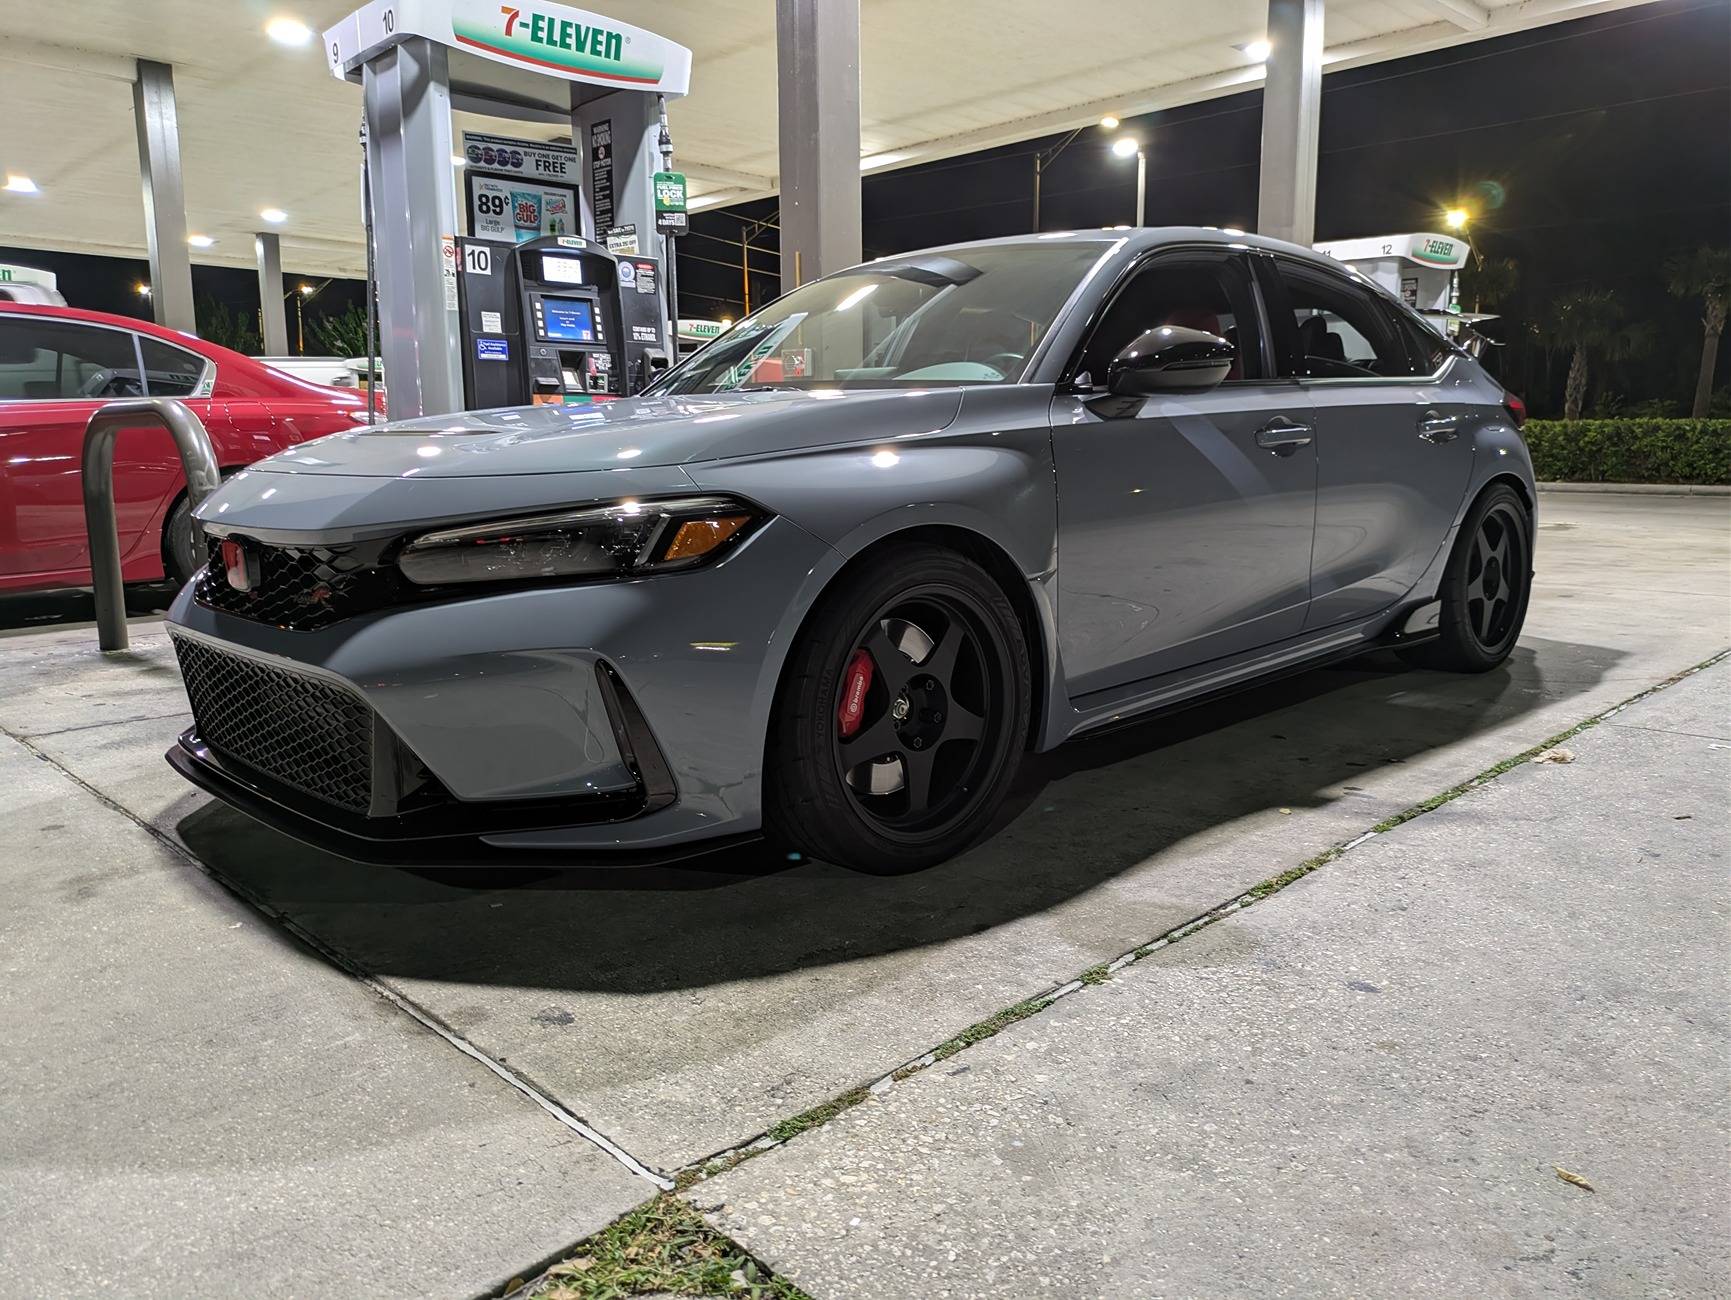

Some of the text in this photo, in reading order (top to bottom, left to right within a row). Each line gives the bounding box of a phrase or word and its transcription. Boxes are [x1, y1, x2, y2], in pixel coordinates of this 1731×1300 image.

[383, 9, 394, 34] 10
[332, 42, 339, 64] 9
[537, 152, 551, 160] ONE
[535, 159, 567, 174] FREE
[657, 189, 684, 199] LOCK
[485, 218, 500, 226] Large
[515, 212, 539, 224] GULP
[1381, 244, 1393, 255] 12
[467, 249, 489, 271] 10
[853, 676, 864, 703] brembo
[816, 666, 833, 738] YOKOHAMA
